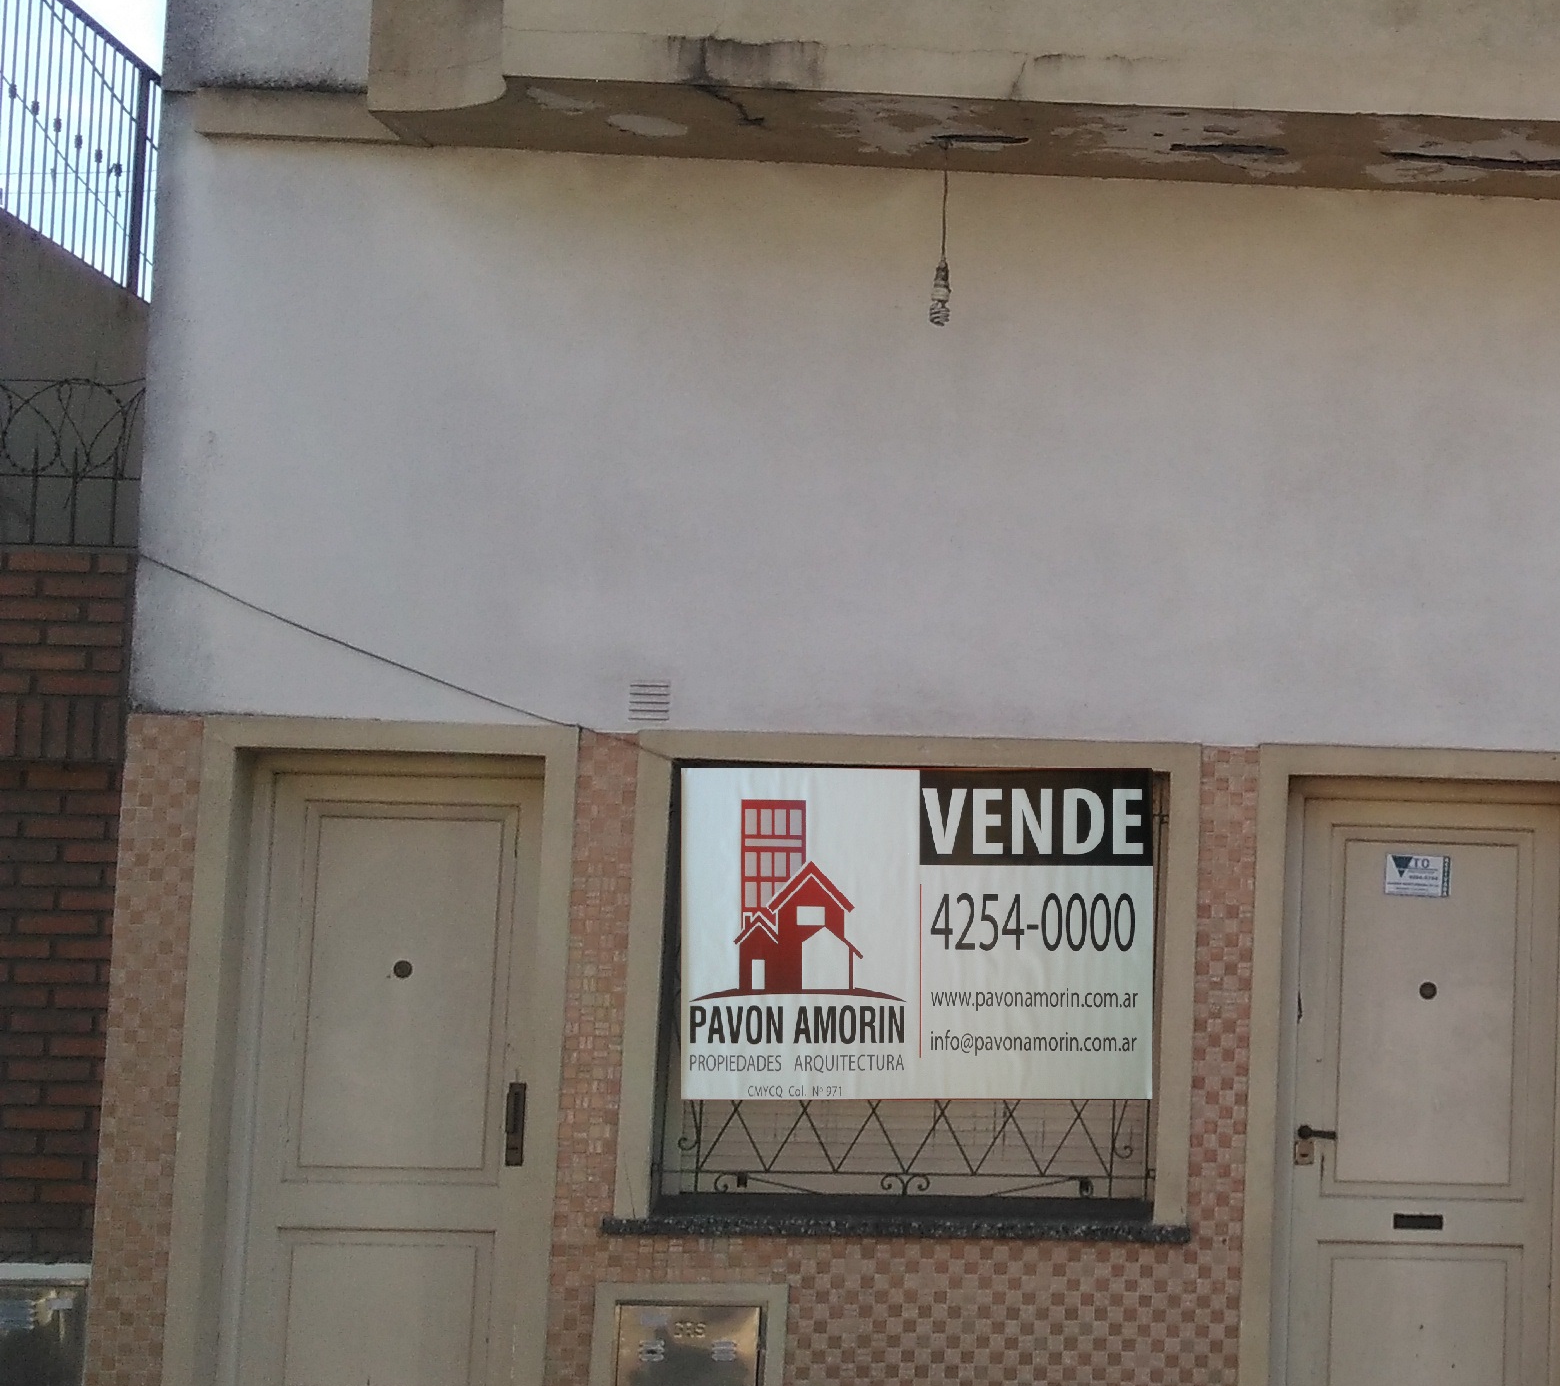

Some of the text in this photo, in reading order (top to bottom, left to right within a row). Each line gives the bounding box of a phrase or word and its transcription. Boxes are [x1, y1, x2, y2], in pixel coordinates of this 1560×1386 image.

[922, 787, 1144, 855] VENDE
[930, 892, 1136, 952] 4254-0000
[930, 987, 1139, 1011] www.pavonamorin.com.ar
[689, 1004, 905, 1044] PAVON AMORIN
[930, 1029, 1138, 1056] info@pavonamorin.com.ar
[689, 1054, 905, 1073] PROPIEDADES ARQUITECTURA
[747, 1085, 783, 1098] CMYCQ
[826, 1085, 842, 1097] 971
